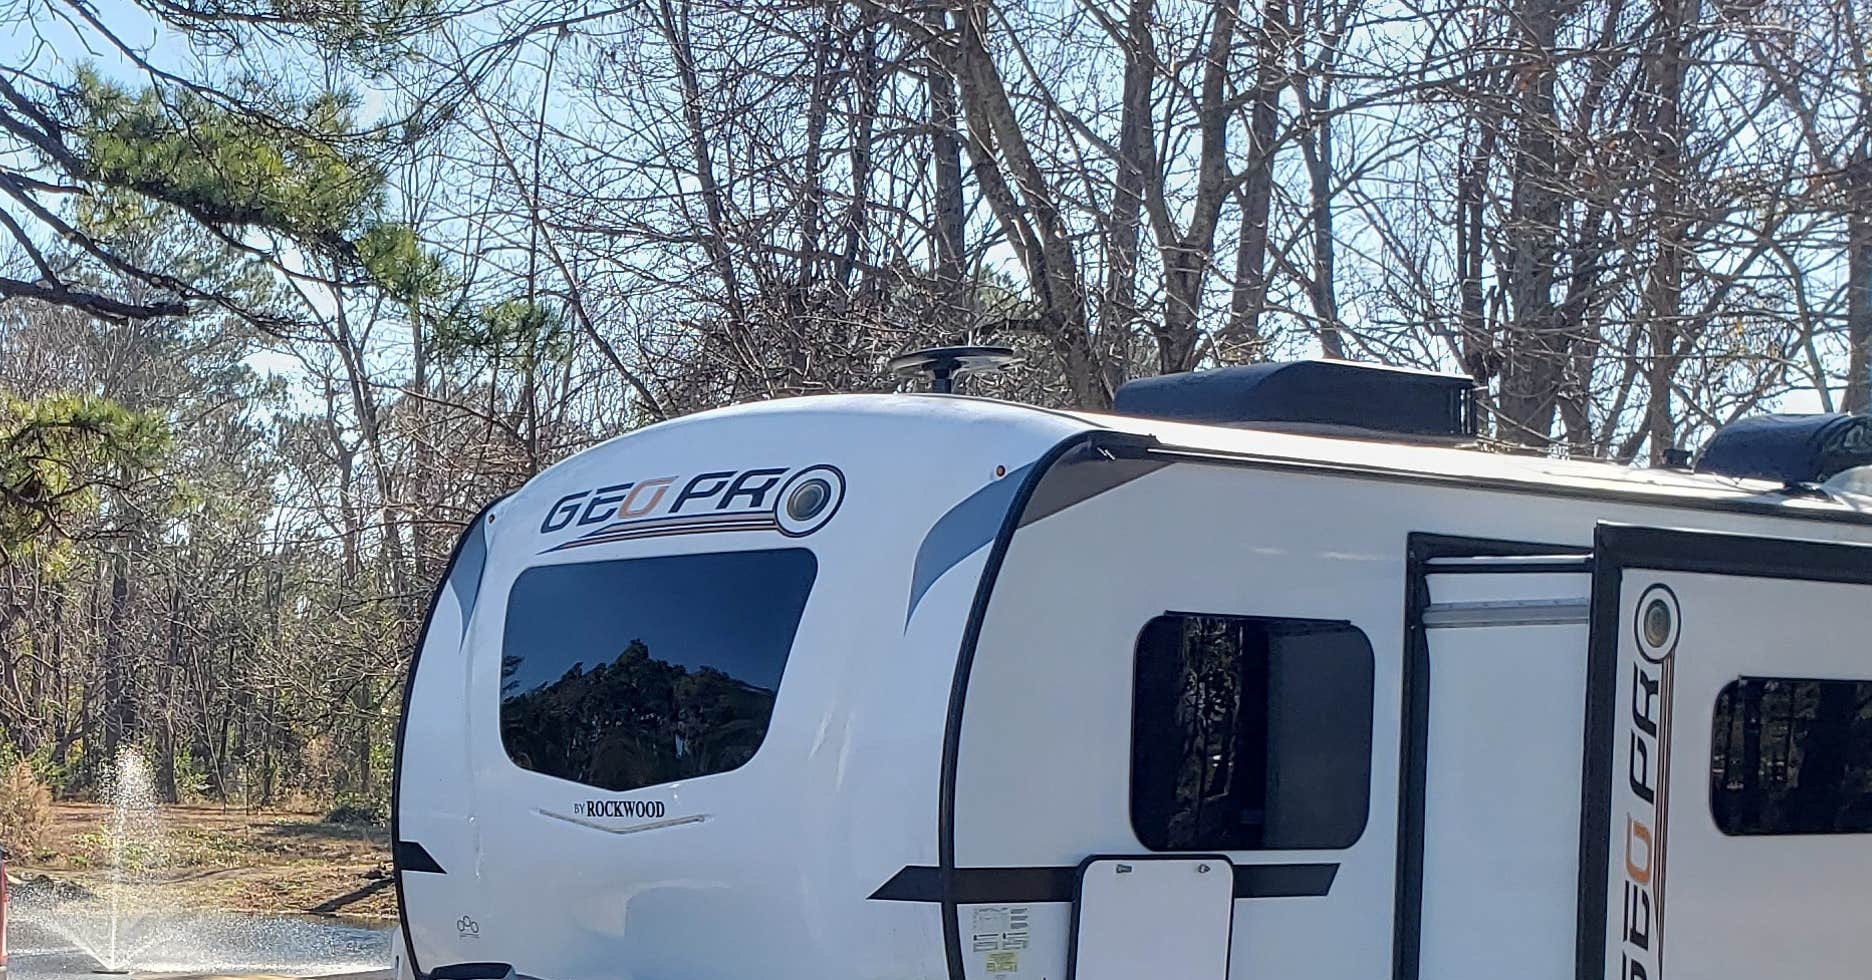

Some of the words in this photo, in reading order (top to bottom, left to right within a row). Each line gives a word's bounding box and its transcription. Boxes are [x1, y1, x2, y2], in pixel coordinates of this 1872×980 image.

[540, 475, 679, 534] GEO
[668, 463, 847, 539] PRO
[1629, 582, 1682, 806] PRO
[574, 803, 585, 815] BY
[587, 800, 665, 818] ROCKWOOD
